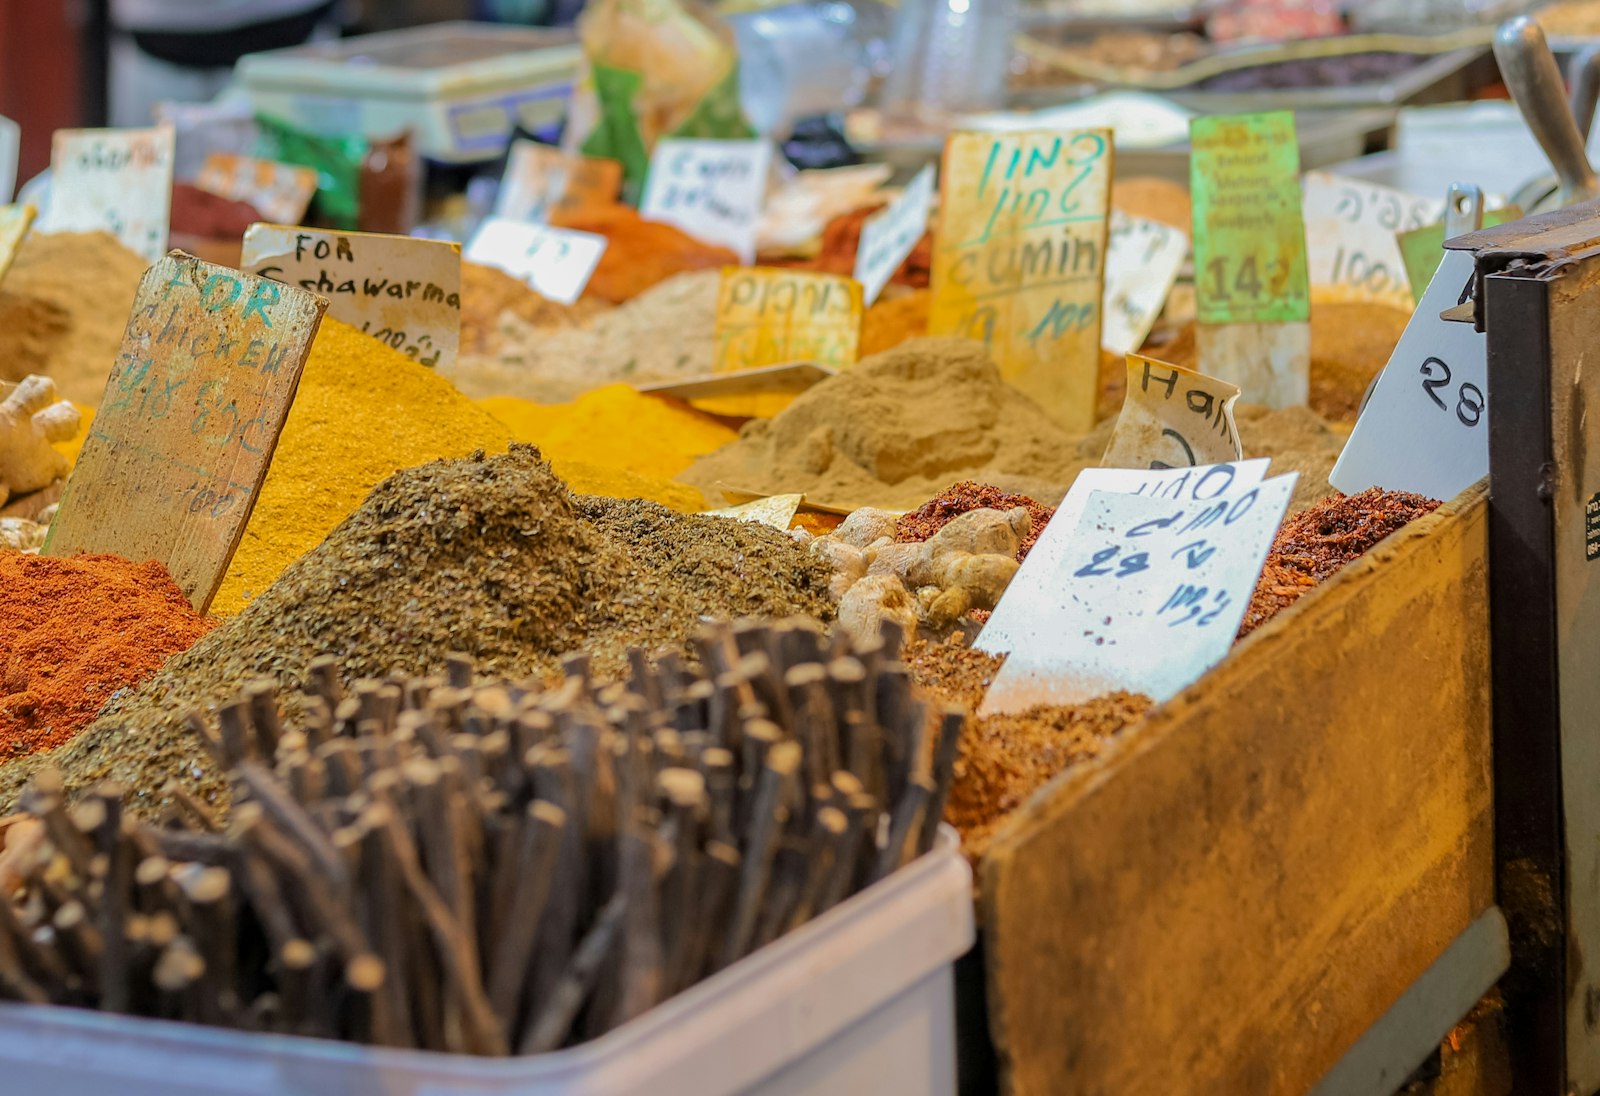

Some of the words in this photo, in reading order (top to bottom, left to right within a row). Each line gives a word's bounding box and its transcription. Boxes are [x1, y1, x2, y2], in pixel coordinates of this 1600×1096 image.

[296, 234, 354, 262] FOR
[161, 260, 281, 329] FOR
[1420, 356, 1485, 427] 28
